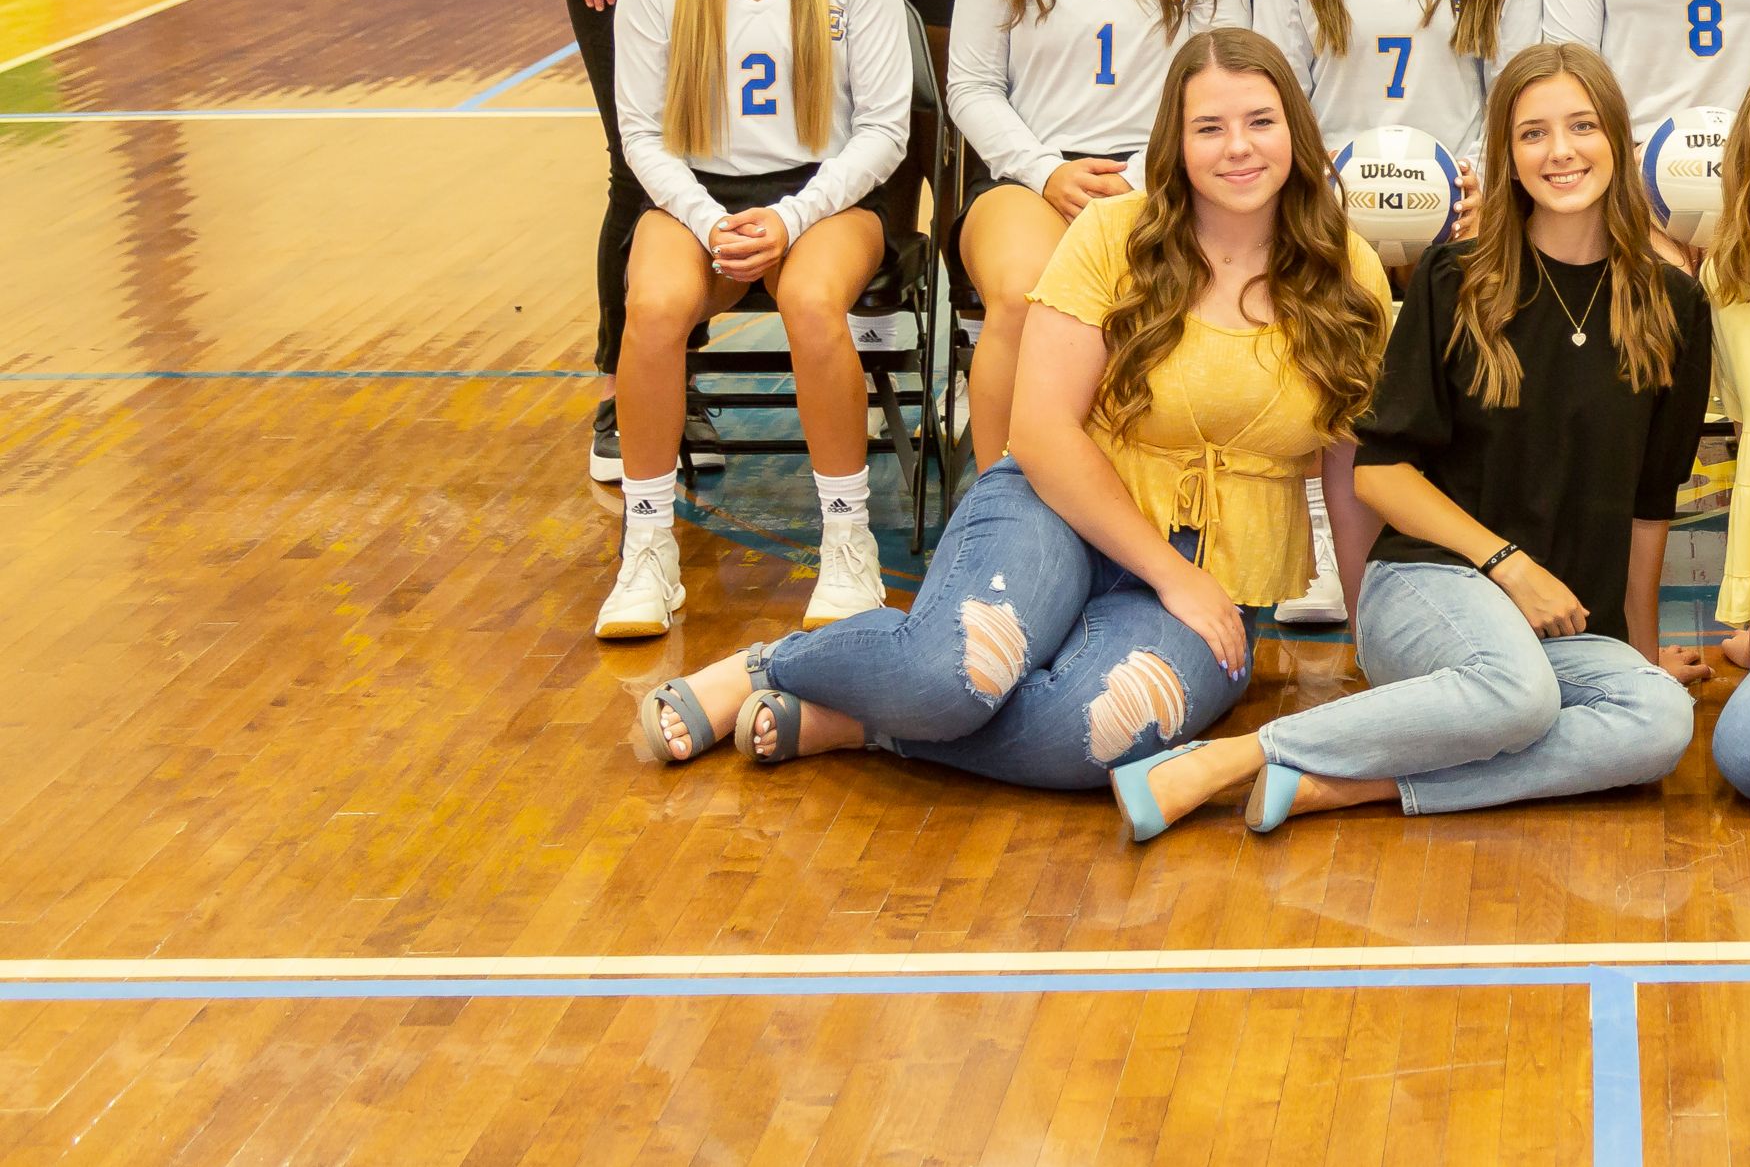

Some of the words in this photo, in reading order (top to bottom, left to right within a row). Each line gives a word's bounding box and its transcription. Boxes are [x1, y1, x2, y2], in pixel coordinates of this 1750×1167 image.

[1094, 21, 1118, 87] 1
[1376, 35, 1414, 101] 7
[740, 51, 779, 117] 2
[1360, 163, 1425, 181] Wilson
[1379, 192, 1403, 210] K1
[827, 506, 852, 514] adidas
